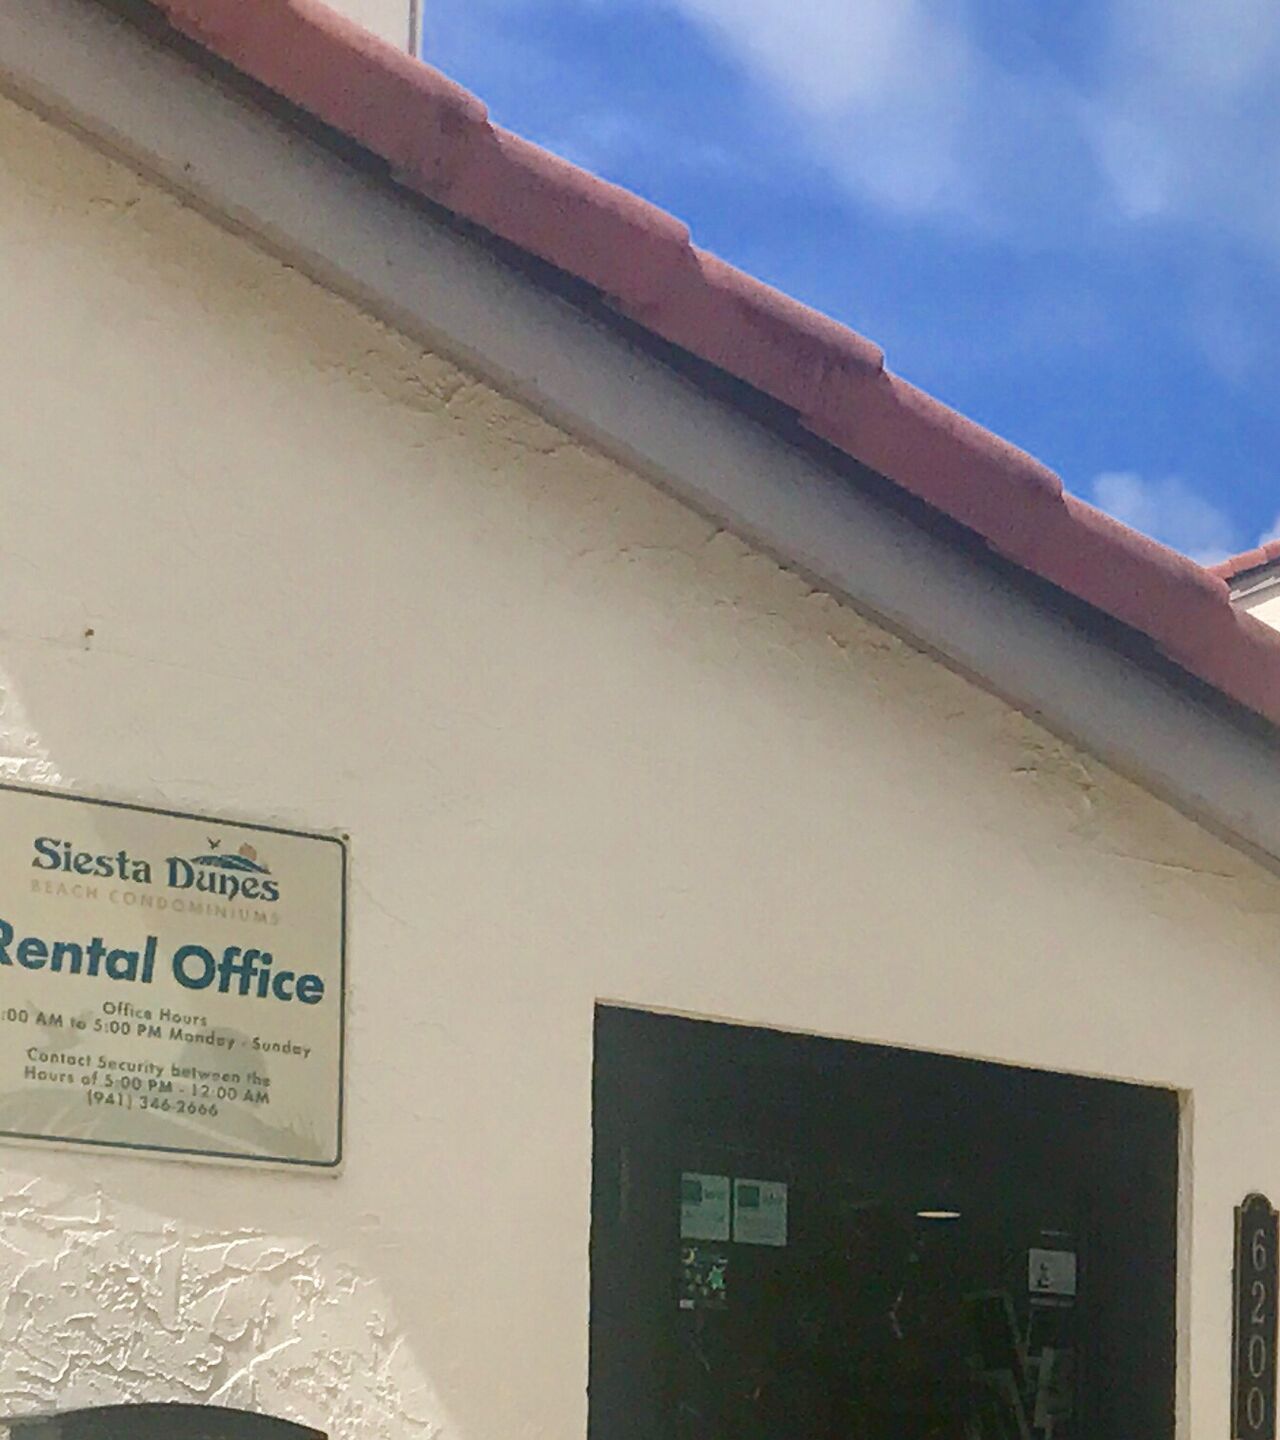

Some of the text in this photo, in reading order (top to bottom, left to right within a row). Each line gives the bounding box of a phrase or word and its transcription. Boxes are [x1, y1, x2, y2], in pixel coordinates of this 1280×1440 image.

[32, 837, 280, 902] Siesta Dunes
[31, 879, 280, 926] BEACH CONDOMINIUMS
[172, 945, 325, 1005] Office
[1, 1008, 29, 1023] :00
[36, 1011, 63, 1028] AM
[70, 1016, 87, 1030] to
[94, 1018, 130, 1035] 5:00
[137, 1023, 162, 1038] PM
[169, 1027, 235, 1050] Monday
[252, 1037, 311, 1058] Sunday
[103, 1001, 207, 1026] Office Hours
[24, 1066, 74, 1083] Hours
[81, 1071, 98, 1085] of
[105, 1074, 142, 1091] 5:00
[148, 1079, 172, 1093] PM
[243, 1089, 270, 1104] AM
[27, 1047, 271, 1087] Contact Security between the
[87, 1089, 132, 1110] (941)
[1247, 1229, 1267, 1430] 6200
